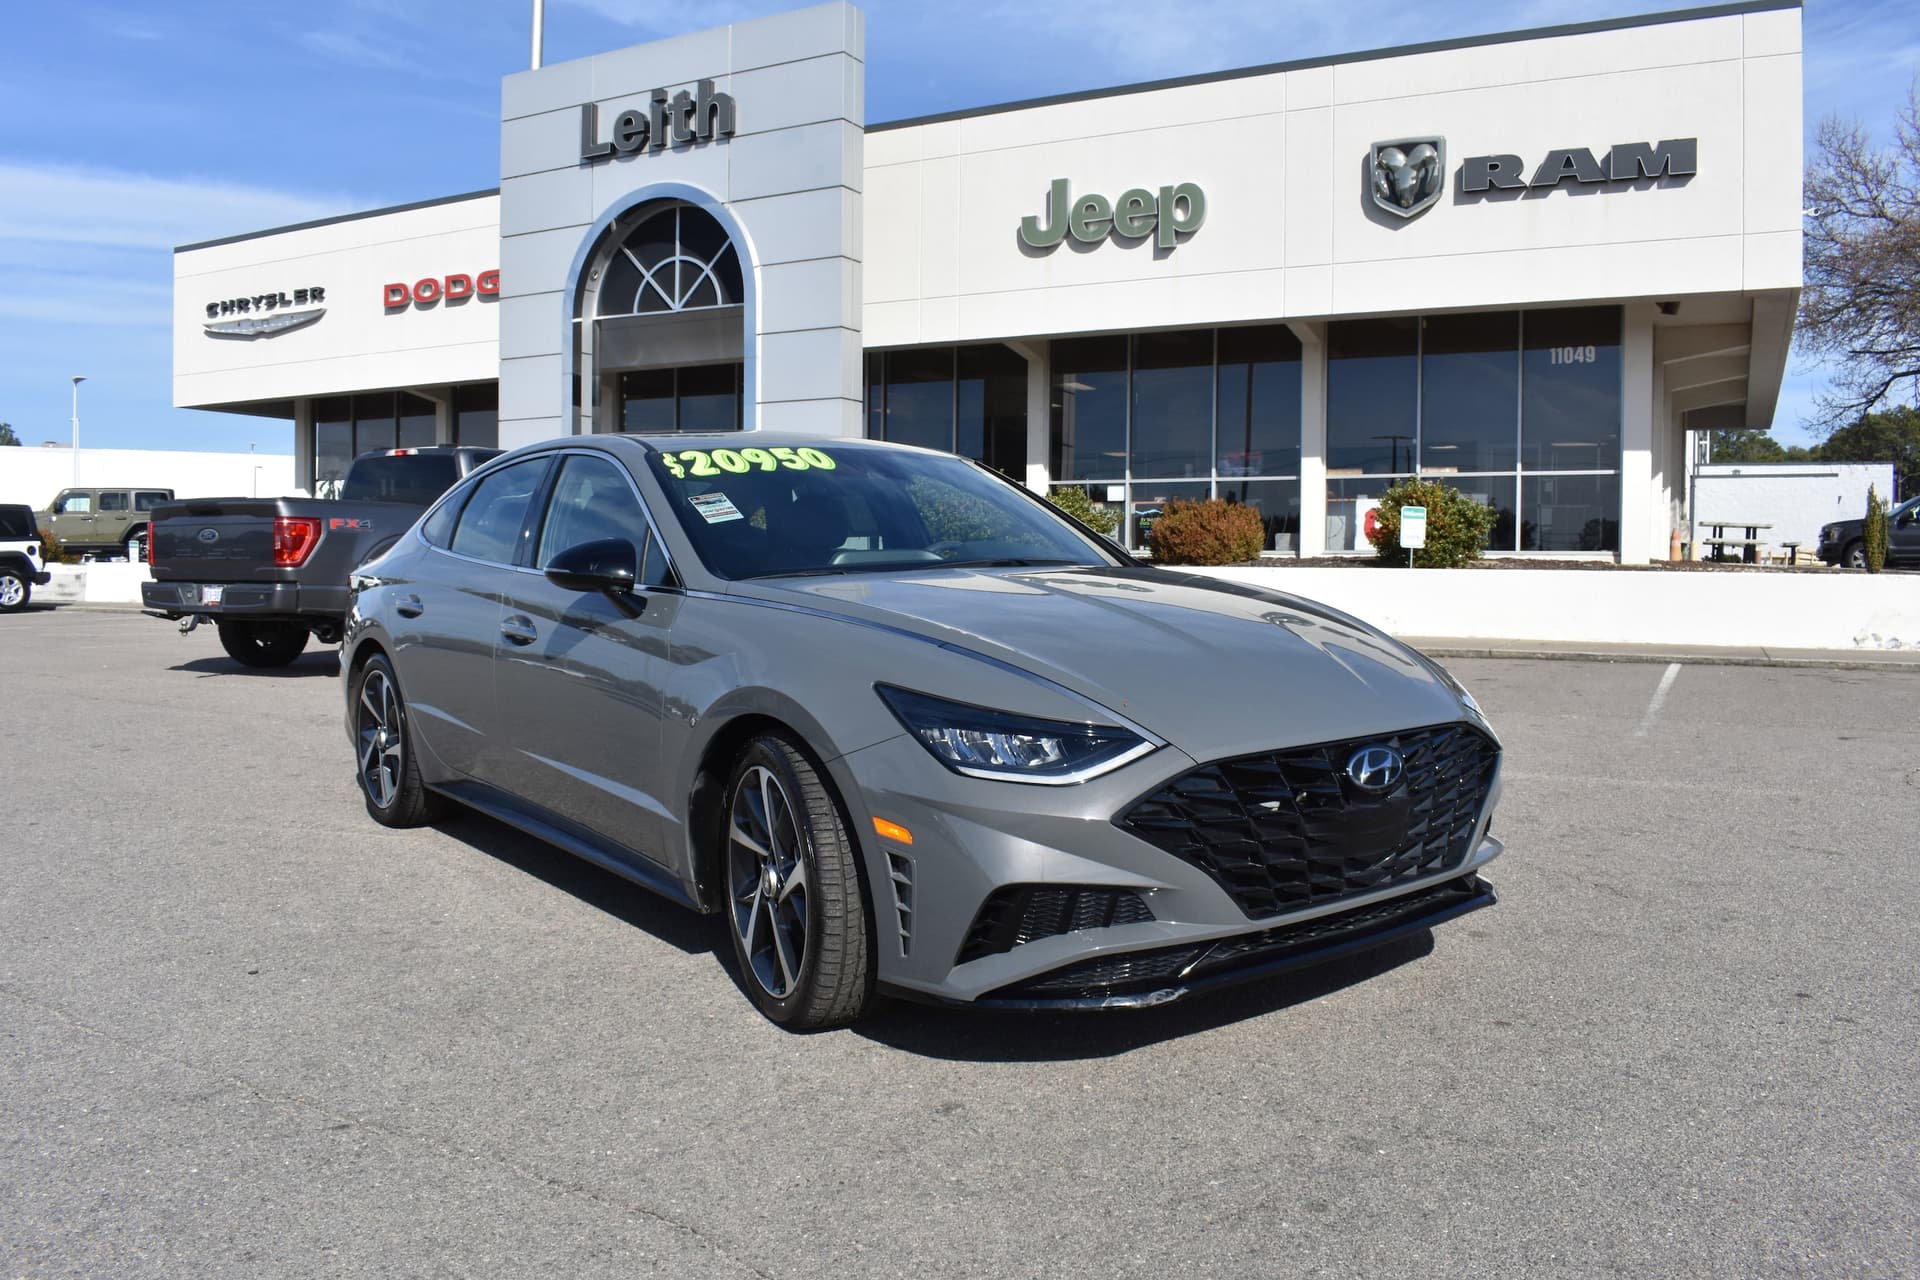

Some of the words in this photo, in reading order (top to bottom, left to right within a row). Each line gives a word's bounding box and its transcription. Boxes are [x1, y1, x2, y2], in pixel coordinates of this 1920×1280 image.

[580, 79, 736, 160] Leith
[1461, 137, 1697, 193] RAM
[1021, 177, 1206, 248] Jeep
[206, 286, 325, 318] CHRYSLER
[384, 268, 500, 307] DODG
[1550, 345, 1596, 364] 11049
[662, 447, 836, 479] $20950
[329, 518, 371, 530] FX4
